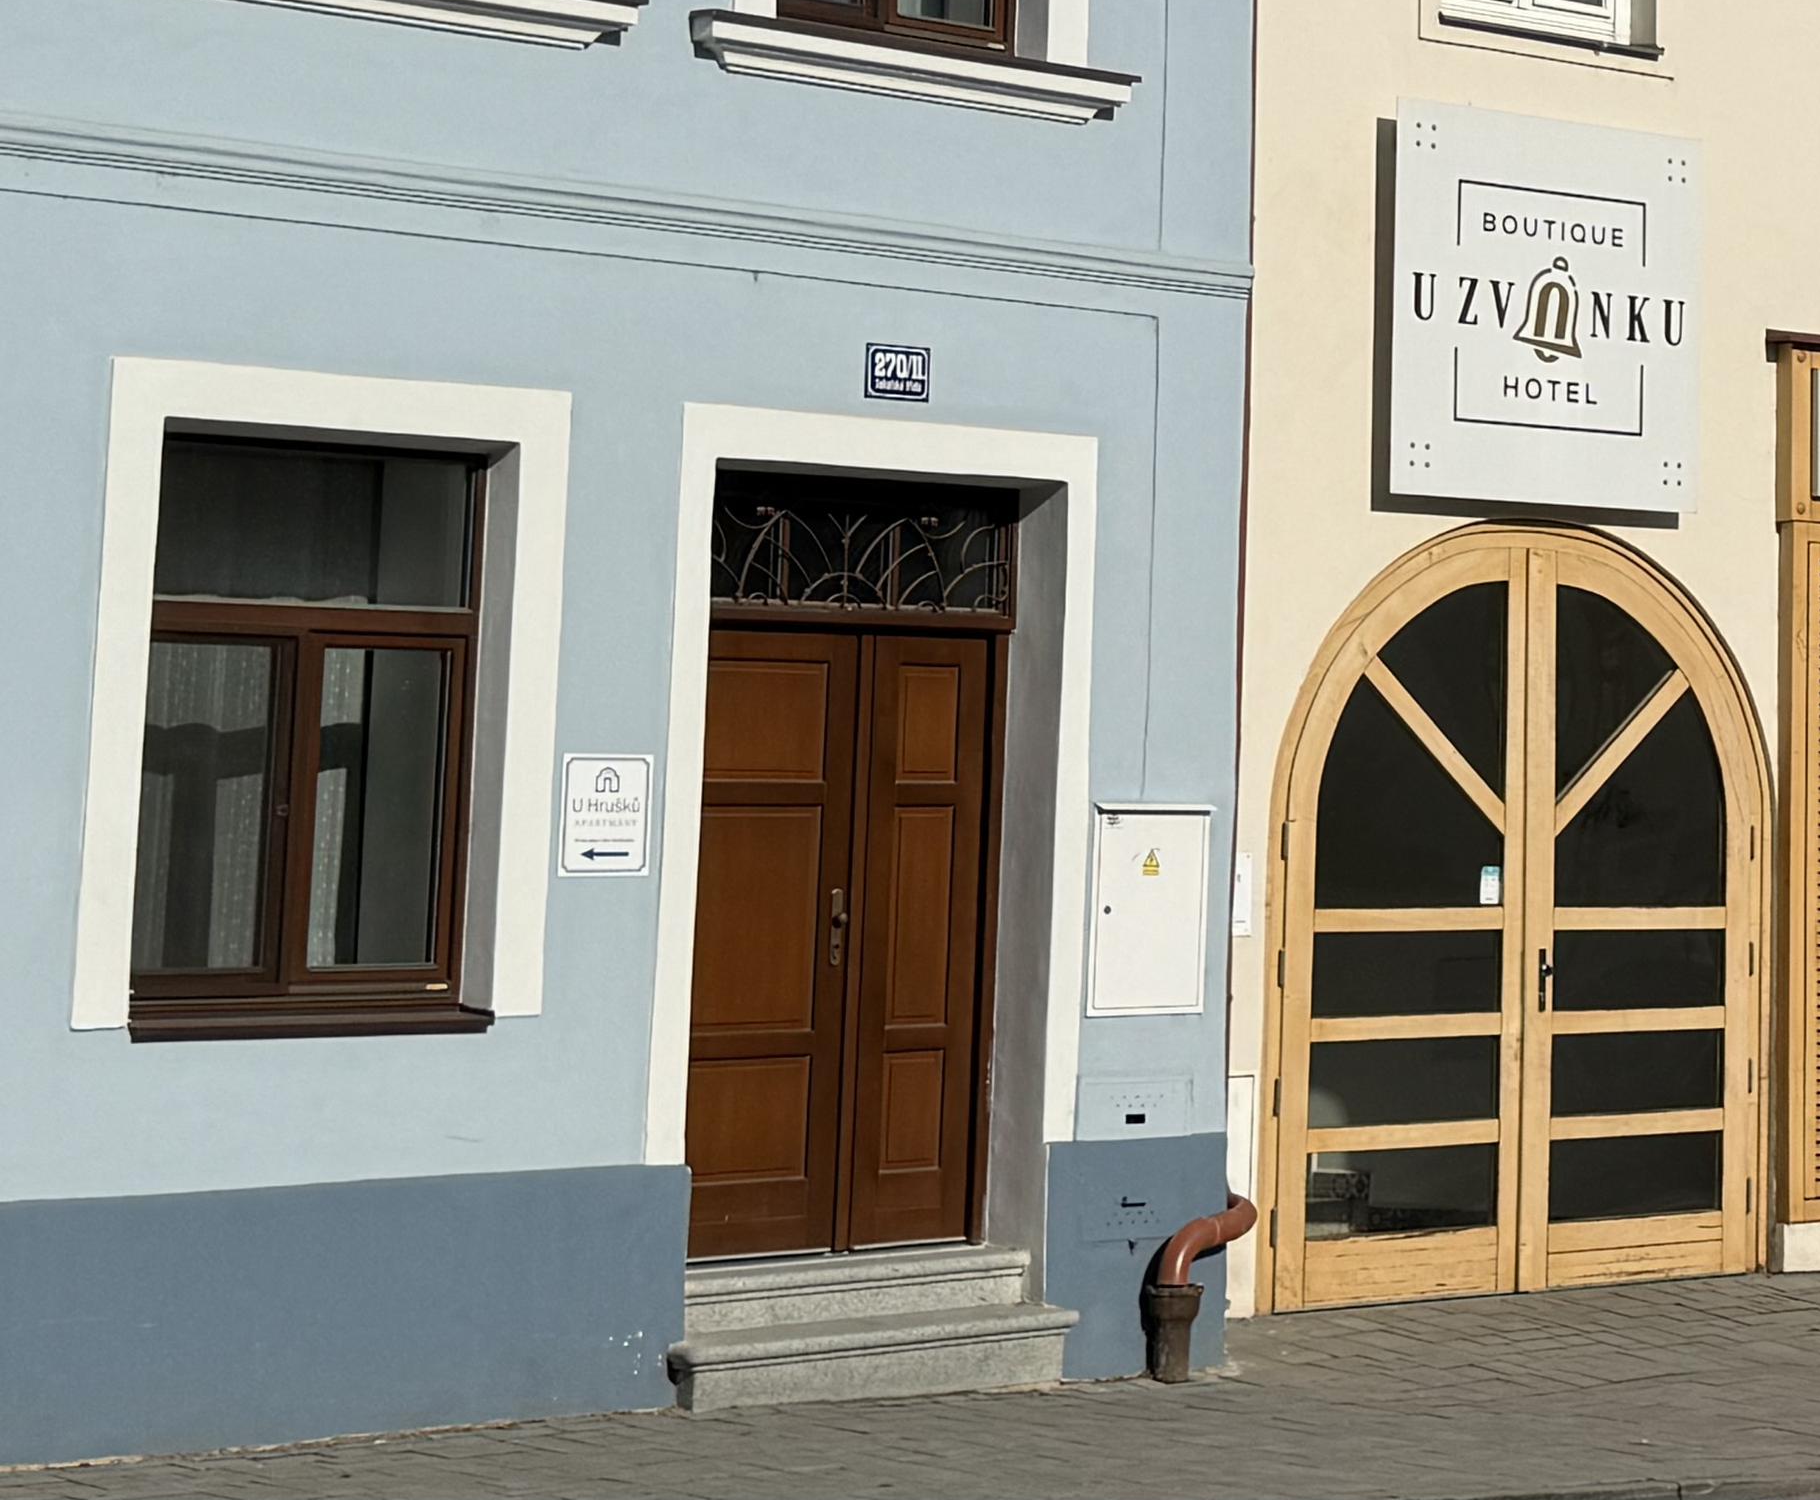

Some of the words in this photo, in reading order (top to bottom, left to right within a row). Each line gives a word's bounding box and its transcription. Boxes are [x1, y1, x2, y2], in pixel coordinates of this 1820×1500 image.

[1482, 212, 1625, 248] BOUTIQUE
[874, 351, 923, 380] 270/II
[1503, 375, 1598, 405] HOTEL
[572, 797, 584, 813] U
[587, 796, 641, 813] Hrušků
